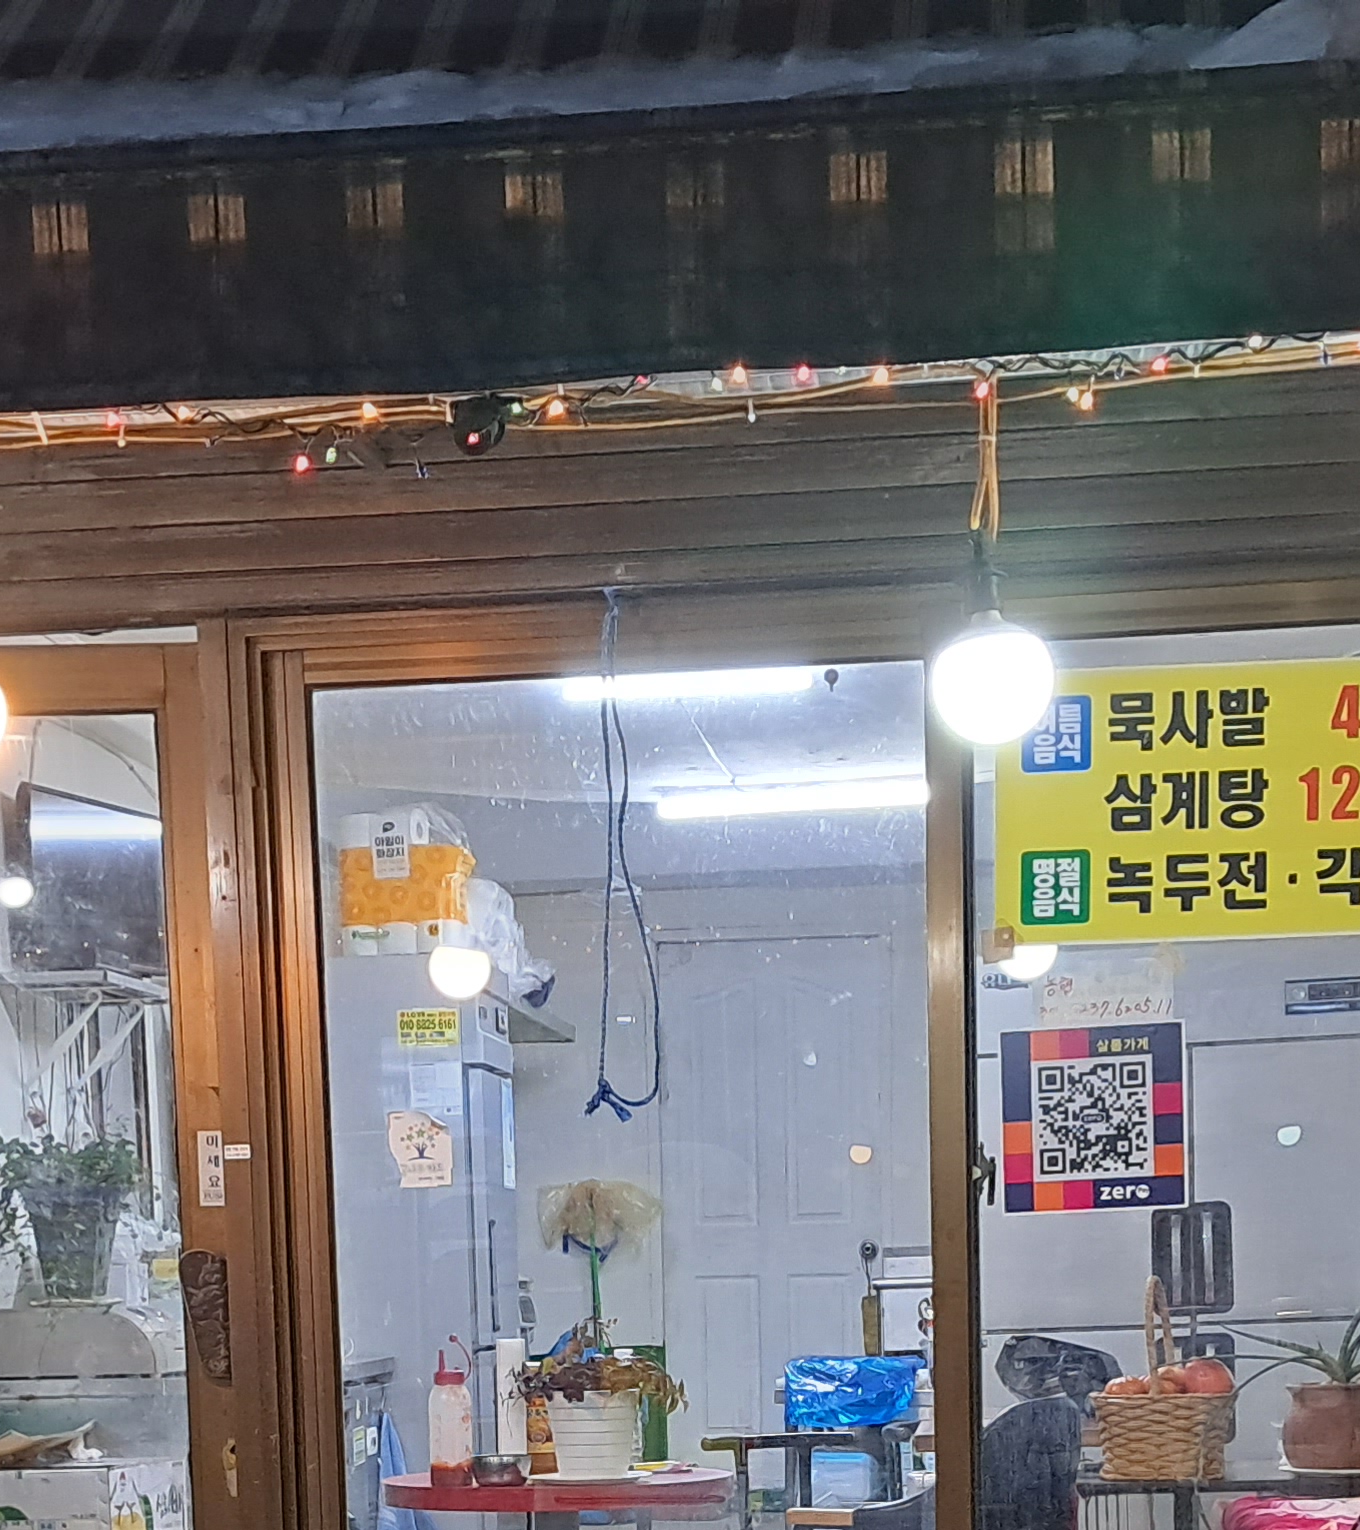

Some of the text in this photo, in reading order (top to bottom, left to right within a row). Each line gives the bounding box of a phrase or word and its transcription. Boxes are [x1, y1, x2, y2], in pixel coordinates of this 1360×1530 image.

[1106, 687, 1270, 752] 묵사발
[1032, 733, 1082, 765] 음식
[1103, 767, 1270, 833] 삼계탕
[1031, 886, 1081, 918] 음식
